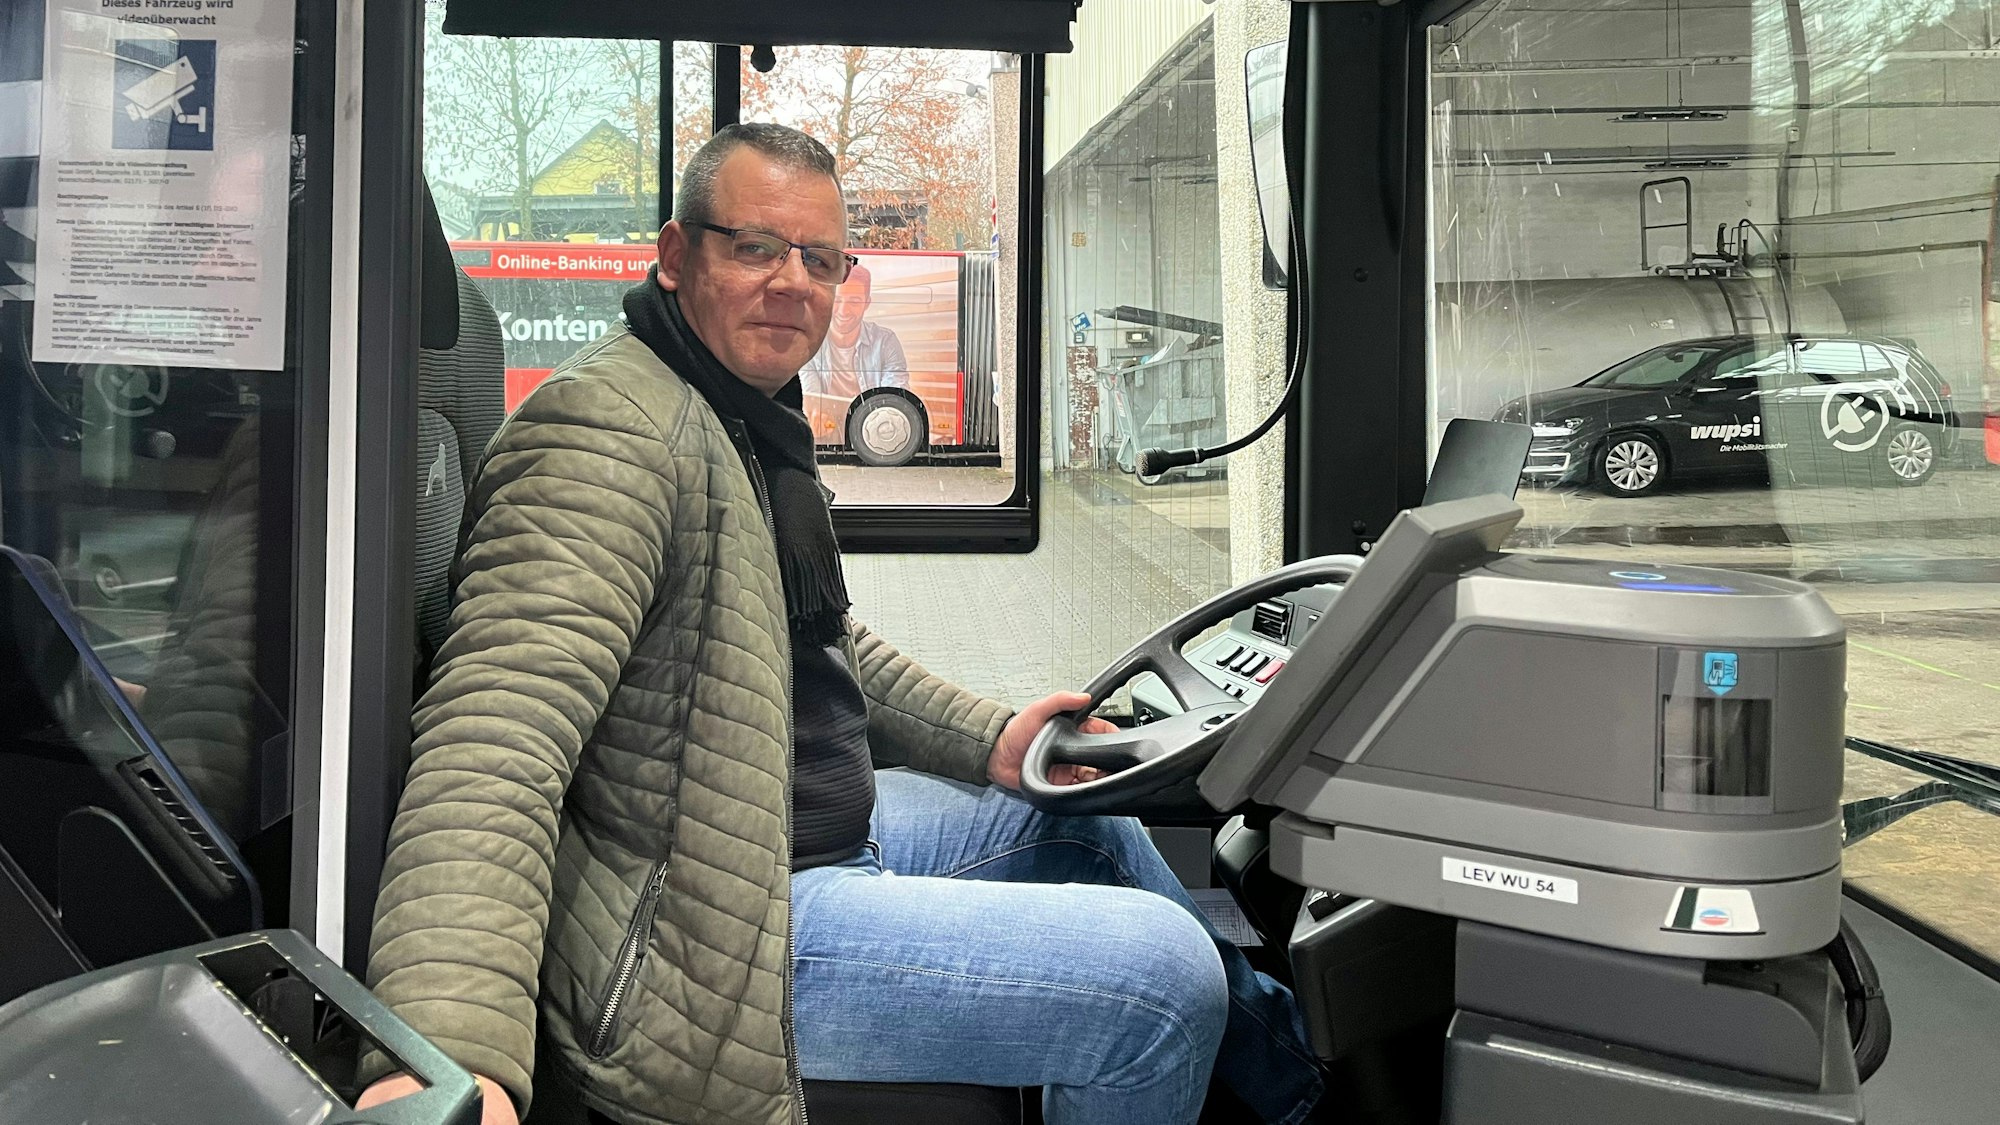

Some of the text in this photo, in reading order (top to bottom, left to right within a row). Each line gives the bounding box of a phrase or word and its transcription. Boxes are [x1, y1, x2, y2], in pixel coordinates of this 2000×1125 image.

[101, 0, 234, 10] Dieses Fahrzeug wird
[117, 14, 217, 25] videoüberwacht
[497, 254, 624, 275] Online-Banking
[1690, 415, 1761, 443] wupsi
[1719, 442, 1789, 453] Die Mobilitätsmacher
[1462, 866, 1556, 894] LEV WU 54
